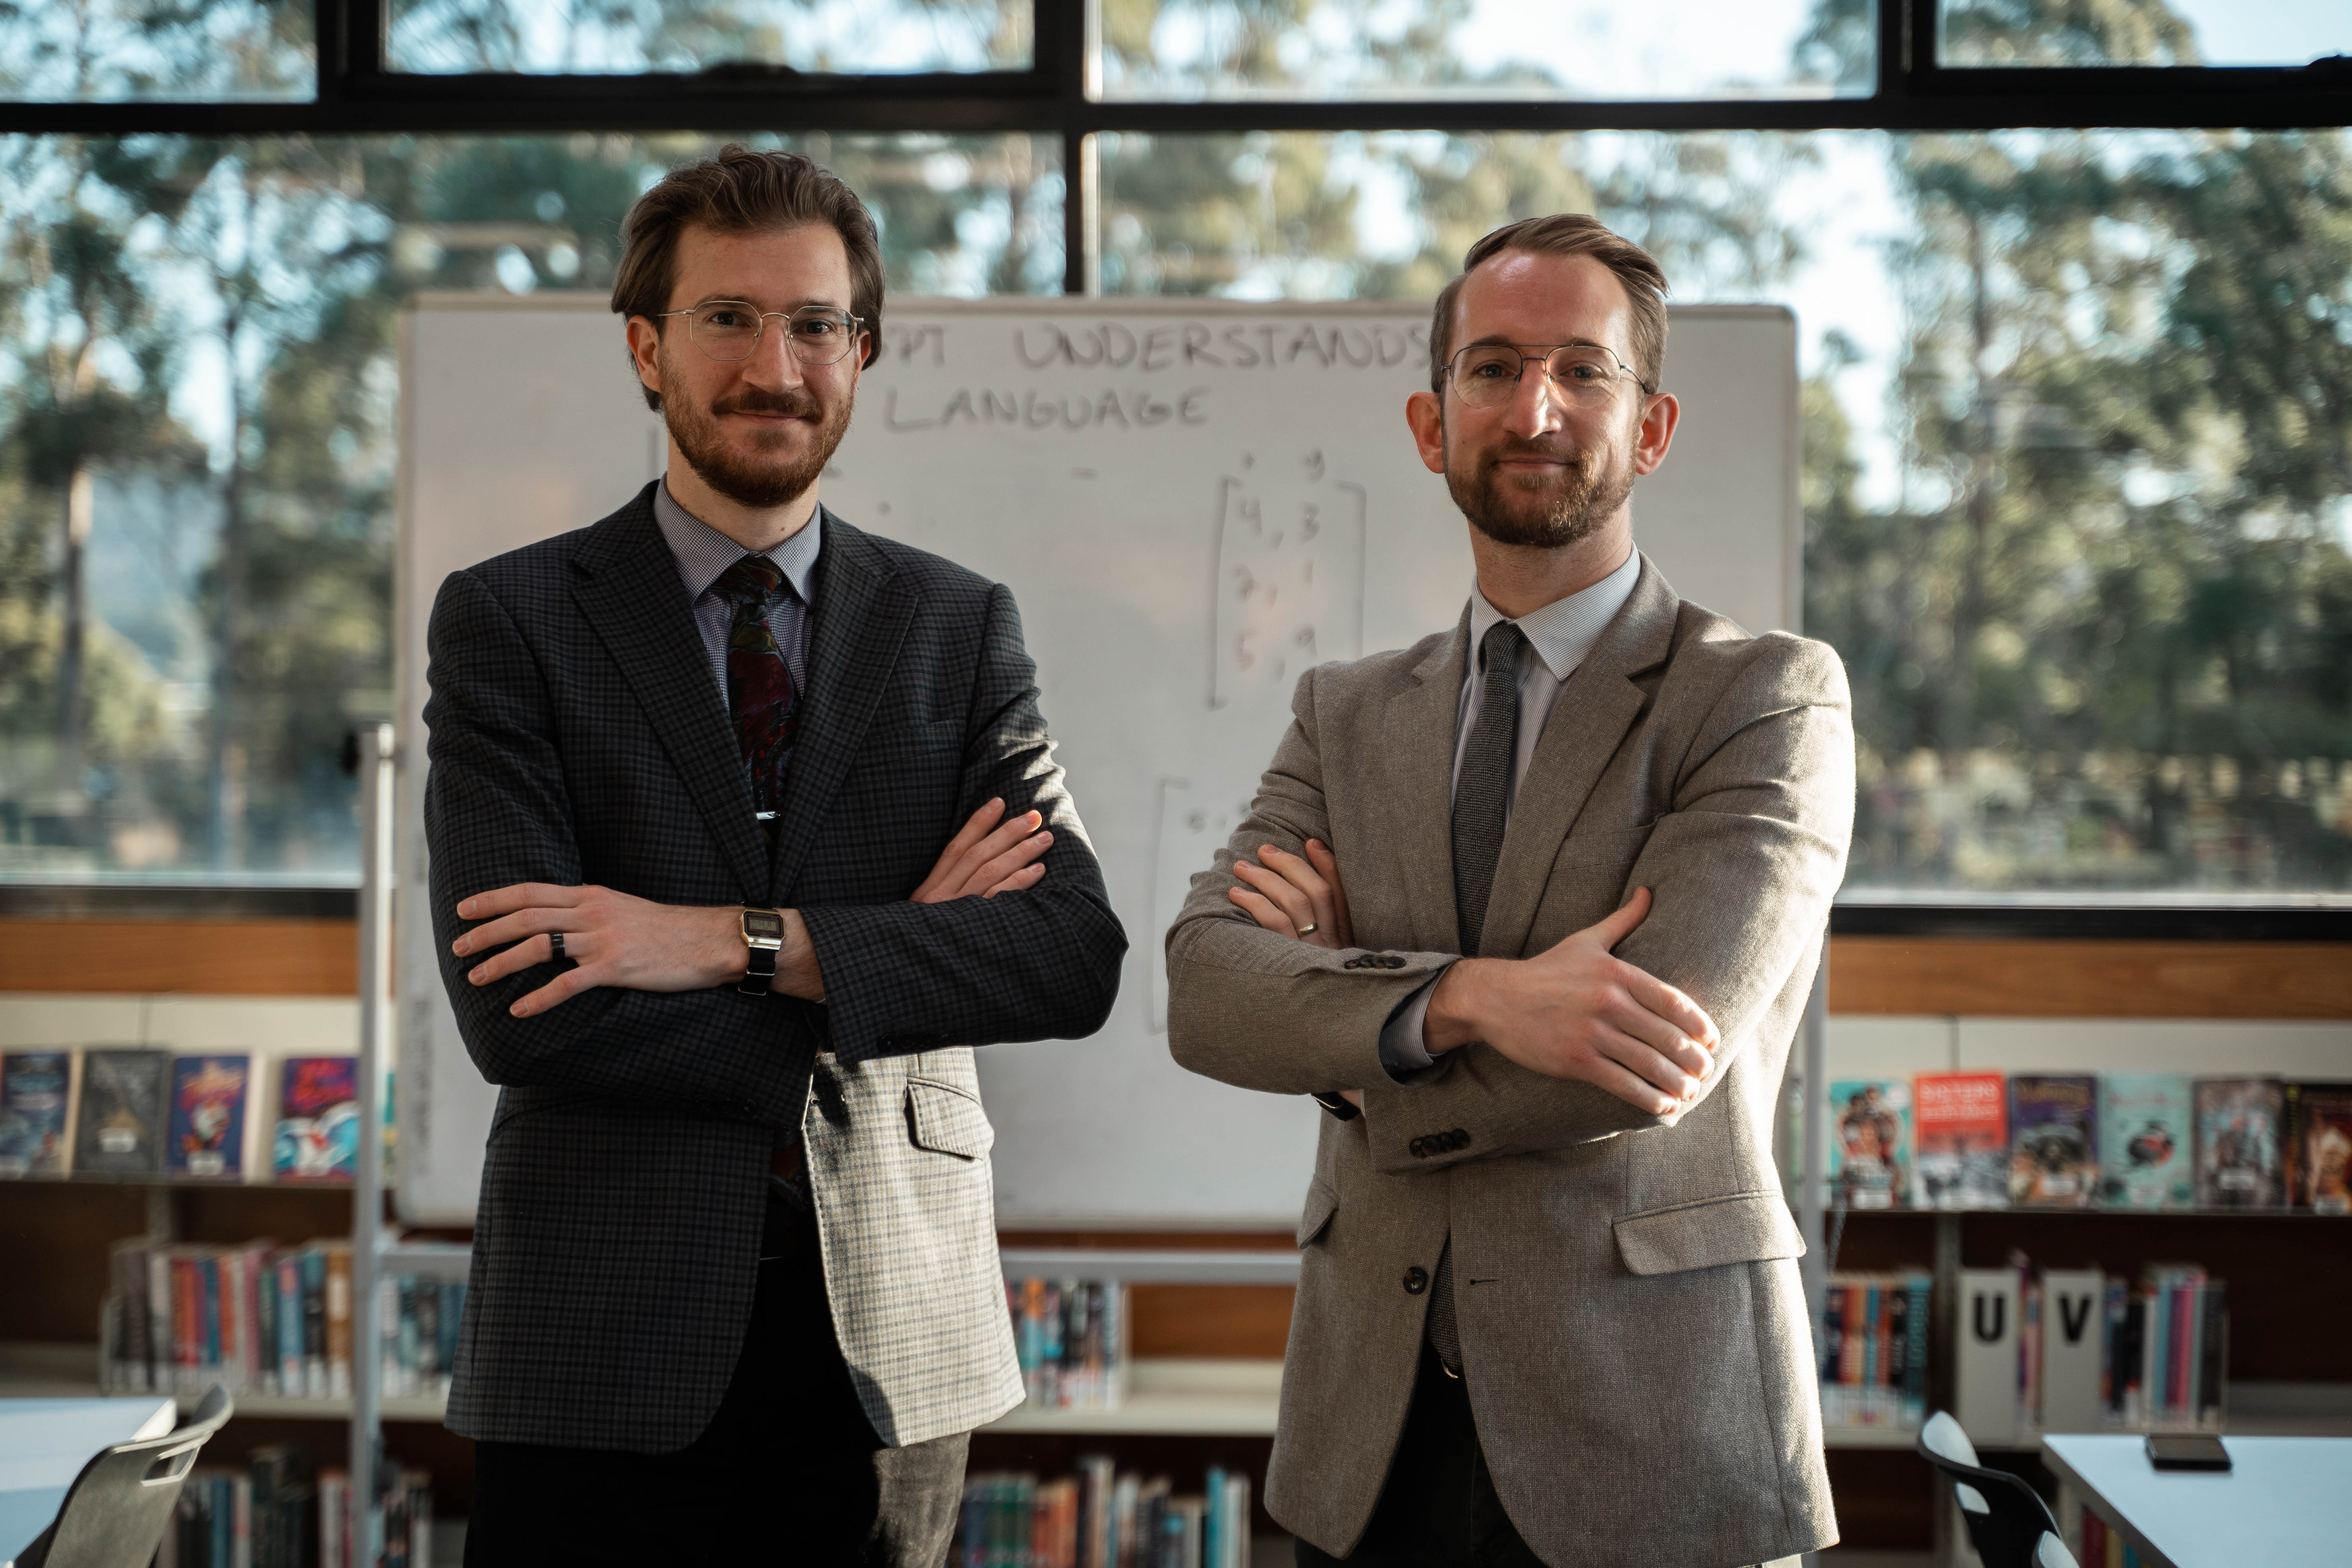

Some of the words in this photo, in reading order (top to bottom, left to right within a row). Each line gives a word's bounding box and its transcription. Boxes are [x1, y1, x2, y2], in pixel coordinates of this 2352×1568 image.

[881, 322, 947, 368] PT
[1016, 321, 1431, 373] UNDERSTANDS
[882, 385, 1210, 433] LANGUAGE
[1974, 1293, 2004, 1345] U
[2057, 1293, 2091, 1344] V
